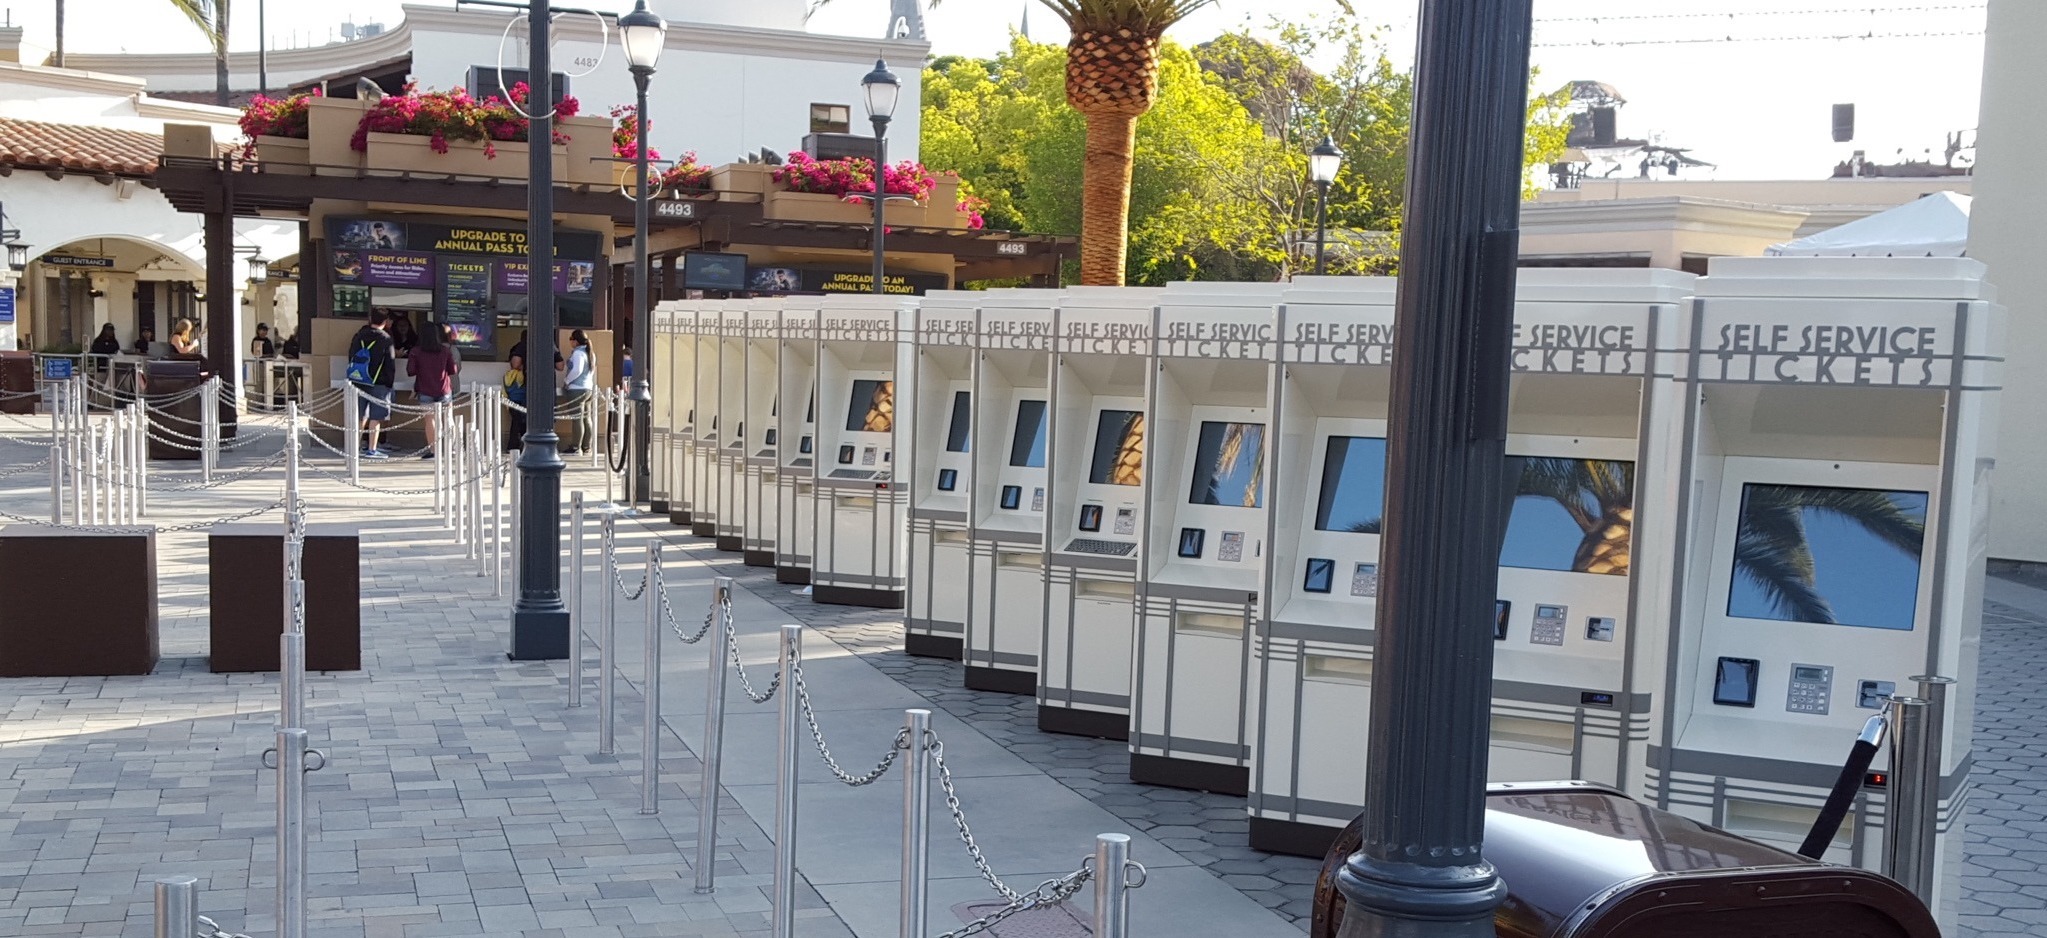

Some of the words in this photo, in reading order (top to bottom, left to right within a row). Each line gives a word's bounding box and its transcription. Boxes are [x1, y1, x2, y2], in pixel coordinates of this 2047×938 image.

[659, 203, 691, 216] 4493
[451, 229, 507, 242] UPGRADE
[509, 232, 525, 243] TO
[435, 240, 483, 252] ANNUAL
[486, 243, 514, 253] PASS
[1000, 243, 1025, 254] 4493
[73, 258, 106, 266] ENTRANCE
[368, 255, 395, 263] FRONT
[409, 257, 428, 265] LINE
[448, 263, 484, 272] TICKETS
[891, 277, 905, 285] AN
[821, 282, 859, 291] ANNUAL
[883, 284, 914, 294] TODAY!
[677, 317, 693, 327] SELF
[702, 317, 718, 327] SELF
[726, 318, 744, 328] SELF
[751, 319, 770, 329] SELF
[786, 319, 807, 329] SELF
[825, 318, 847, 330] SELF
[850, 319, 890, 331] SERVICE
[925, 319, 951, 332] SELF
[987, 321, 1016, 334] SELF
[1020, 321, 1051, 336] SERV
[825, 329, 890, 341] TICKETS
[1067, 322, 1099, 338] SELF
[1168, 322, 1205, 339] SELF
[1210, 323, 1271, 341] SERVIC
[1295, 322, 1339, 342] SELF
[1346, 324, 1395, 344] SERV
[1529, 324, 1634, 349] SERVICE
[926, 331, 973, 346] TICK
[987, 333, 1049, 350] TICKE
[1718, 323, 1789, 352] SELF
[1800, 325, 1936, 355] SERVICE
[1067, 337, 1148, 355] TICKET
[1168, 339, 1267, 359] TICKET
[1295, 341, 1392, 365] TICKE
[1511, 348, 1633, 375] CKETS
[1717, 352, 1933, 386] TICKETS
